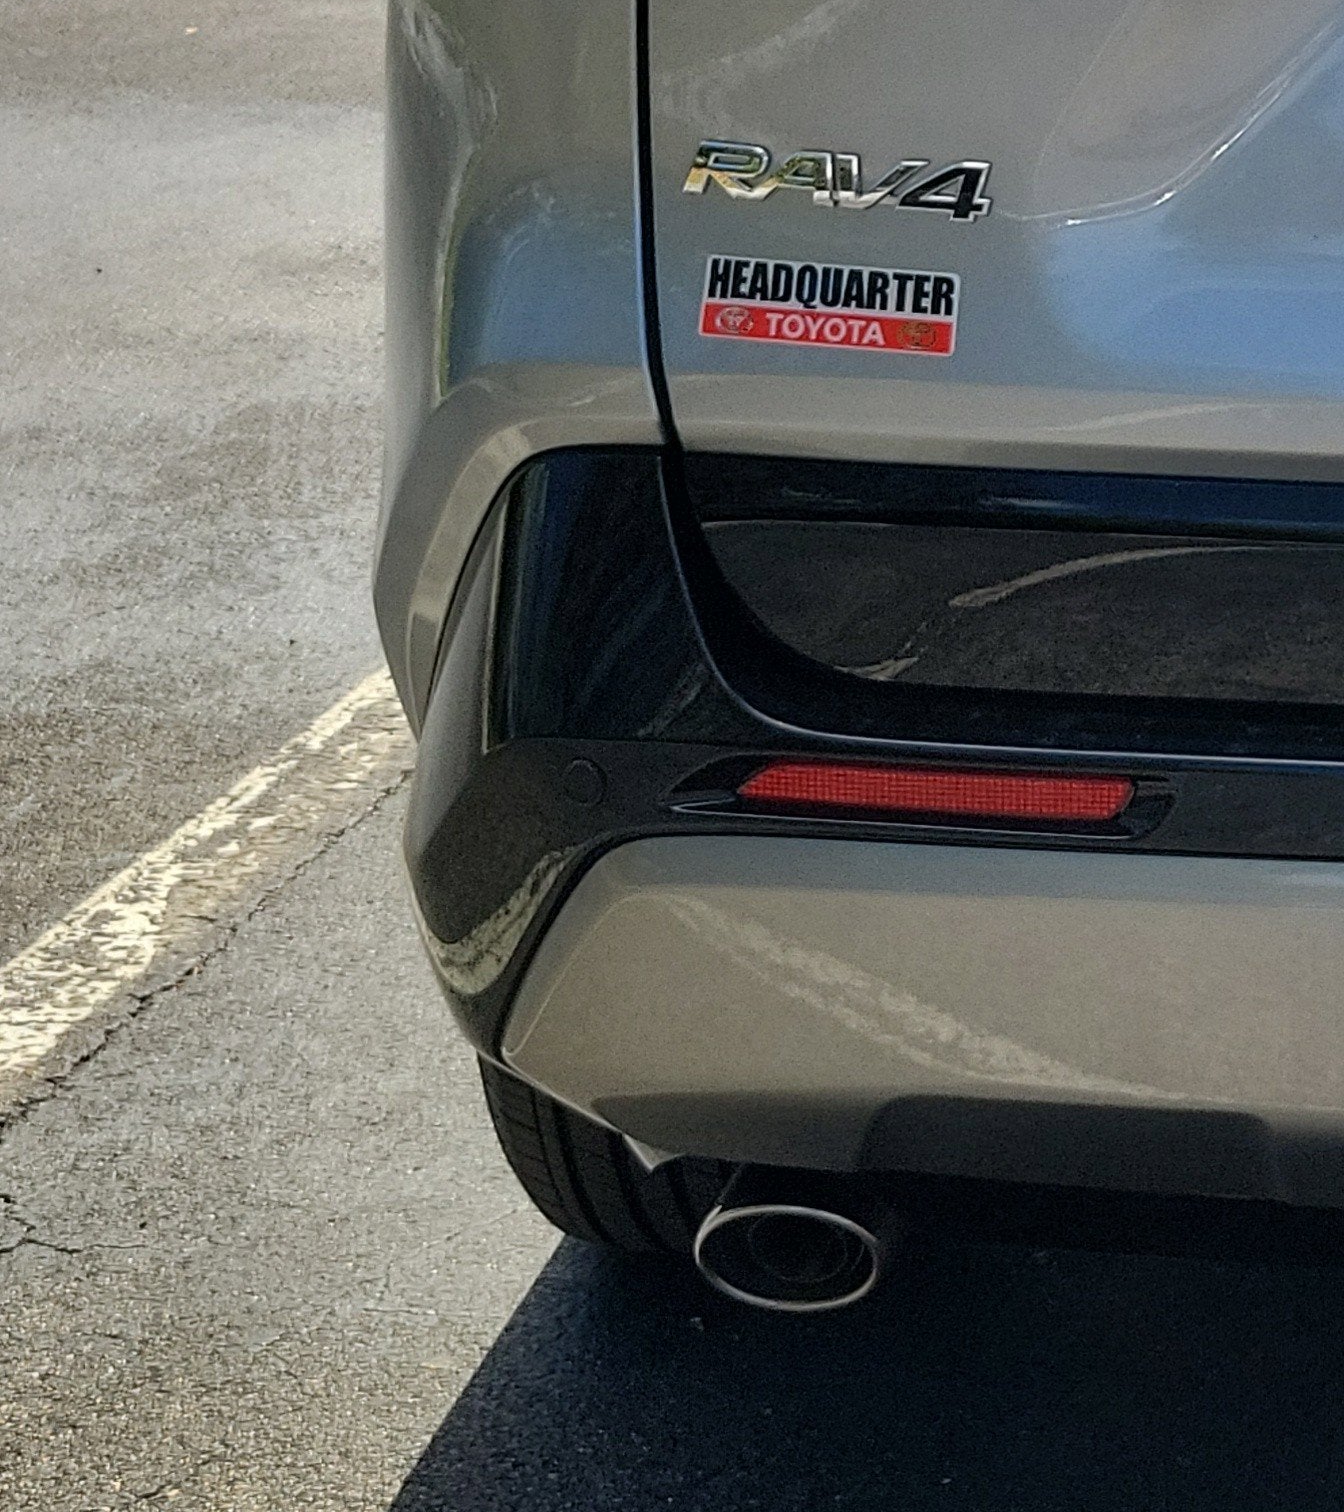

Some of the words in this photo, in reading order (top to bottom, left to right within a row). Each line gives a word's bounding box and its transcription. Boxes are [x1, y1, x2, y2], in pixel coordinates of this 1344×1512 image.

[683, 139, 993, 222] RAV4
[708, 258, 955, 316] HEADQUARTER
[765, 313, 885, 346] TOYOTA
